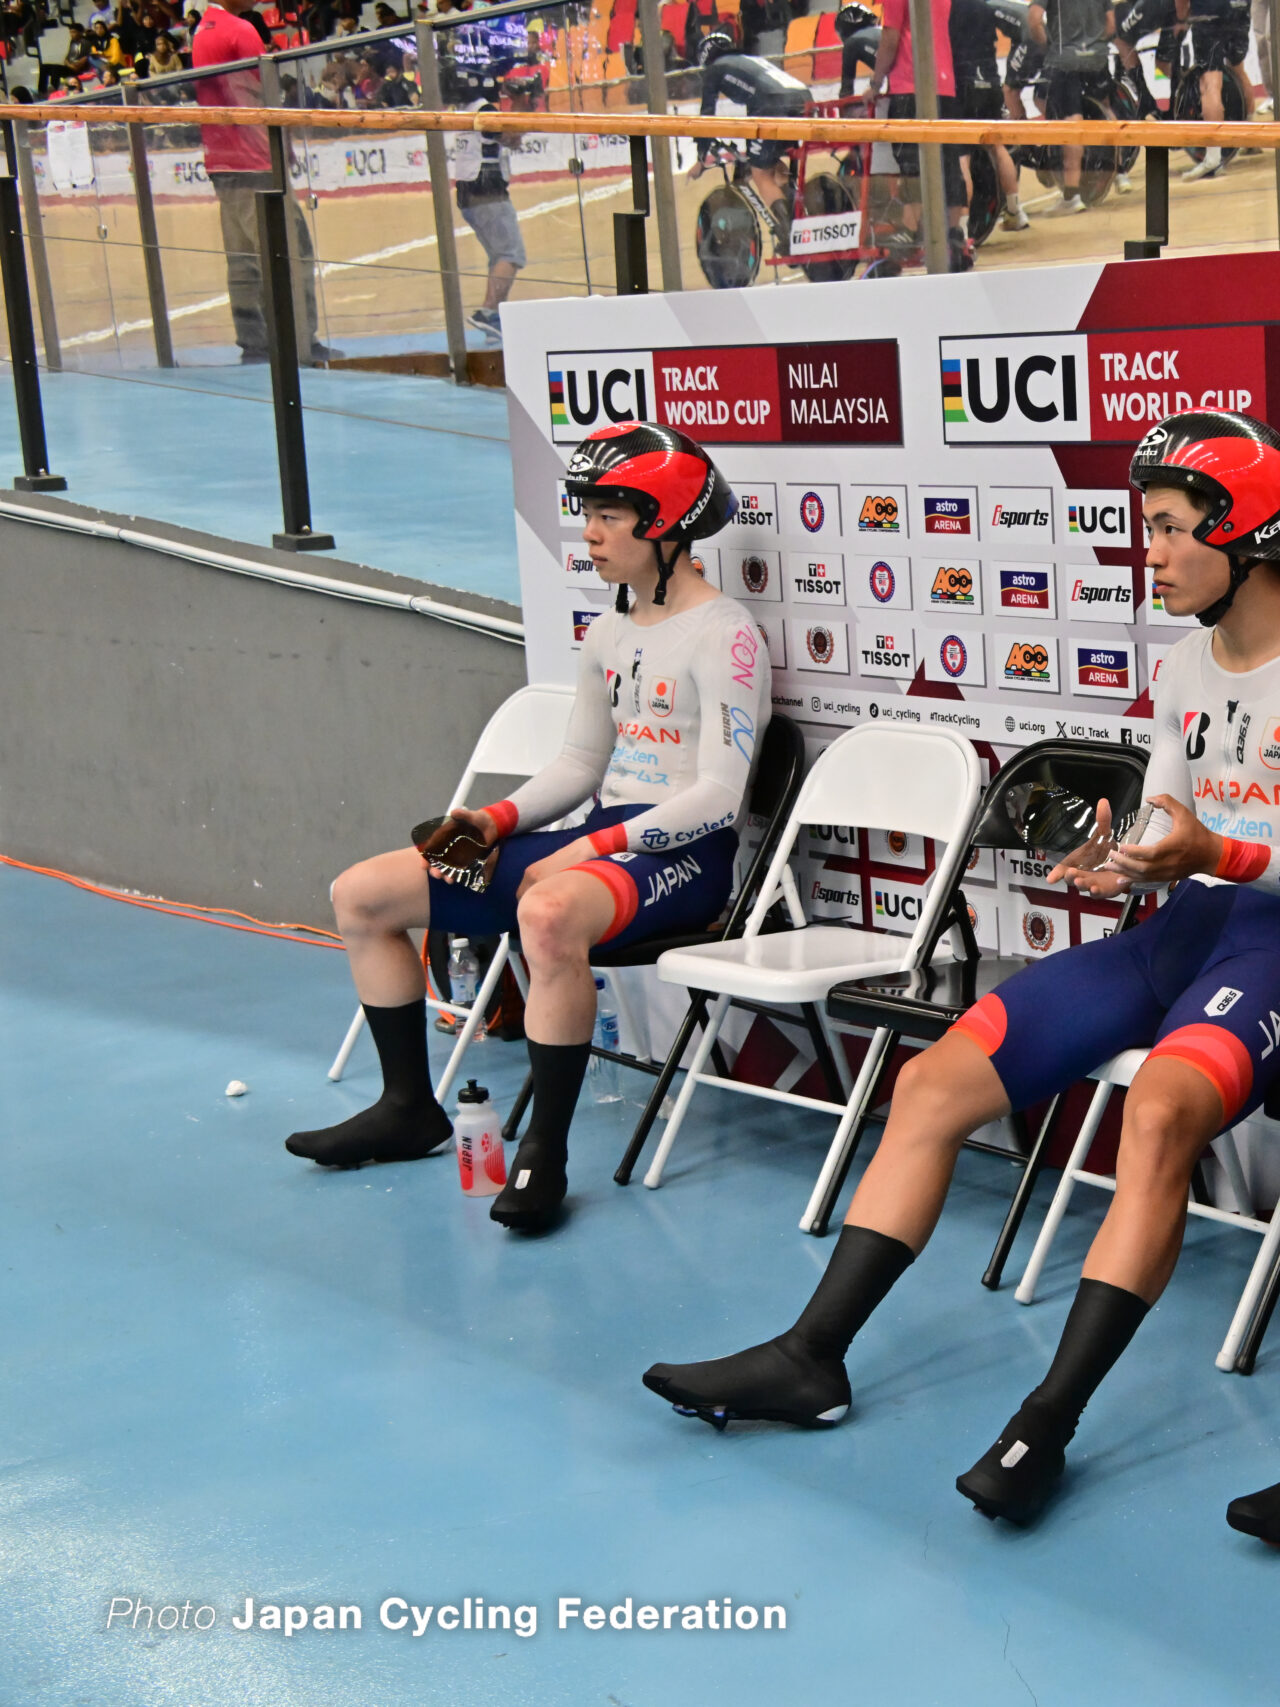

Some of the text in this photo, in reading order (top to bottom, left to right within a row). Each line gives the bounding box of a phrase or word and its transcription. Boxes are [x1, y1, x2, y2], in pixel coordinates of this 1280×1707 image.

[352, 148, 387, 175] UCI
[812, 223, 857, 242] TISSOT
[788, 362, 839, 389] NILAI
[1100, 350, 1180, 381] TRACK
[661, 366, 719, 392] TRACK
[966, 355, 1078, 424] UCI
[567, 368, 648, 425] UCI
[1101, 391, 1192, 422] WORLD
[664, 400, 771, 426] WORLD CUP
[790, 398, 889, 426] MALAYSIA
[680, 468, 716, 530] Kabuto
[935, 501, 958, 512] astro
[934, 520, 961, 531] ARENA
[992, 505, 1049, 528] isports
[1078, 505, 1126, 534] UCI
[795, 578, 841, 595] TISSOT
[1012, 573, 1036, 586] astro
[1071, 579, 1132, 604] isports
[1010, 593, 1040, 605] ARENA
[861, 650, 911, 668] TISSOT
[1090, 652, 1115, 665] astro
[1088, 672, 1119, 684] ARENA
[823, 701, 861, 716] uci_cycling
[882, 707, 921, 722] uci_cycling
[930, 712, 980, 728] #TrackCycling
[721, 702, 732, 747] KEIRIN
[1019, 720, 1046, 735] uci.org
[1070, 725, 1110, 740] UCI_Track
[1236, 712, 1251, 765] Q36.5
[675, 811, 735, 843] Cyclers
[643, 854, 702, 907] JAPAN
[1010, 859, 1054, 878] TISSO
[811, 881, 860, 906] isports
[1216, 990, 1238, 1013] Q36.5
[461, 1136, 473, 1172] JAPAN
